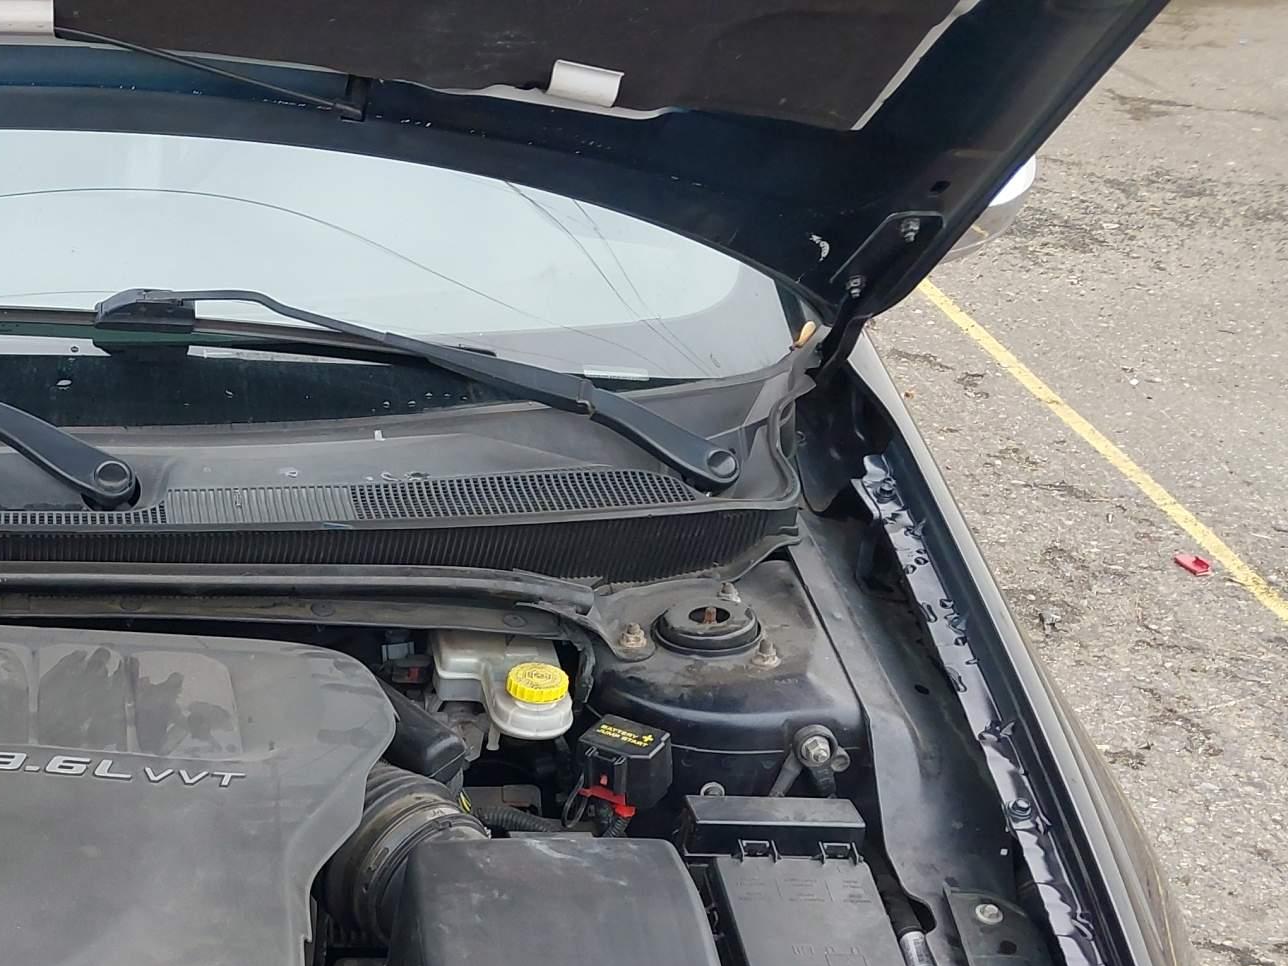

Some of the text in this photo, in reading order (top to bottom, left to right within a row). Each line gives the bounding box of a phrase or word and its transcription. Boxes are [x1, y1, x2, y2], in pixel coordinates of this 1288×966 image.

[596, 728, 649, 747] JUMP START
[600, 724, 639, 739] BATTERY
[143, 766, 247, 788] VVT
